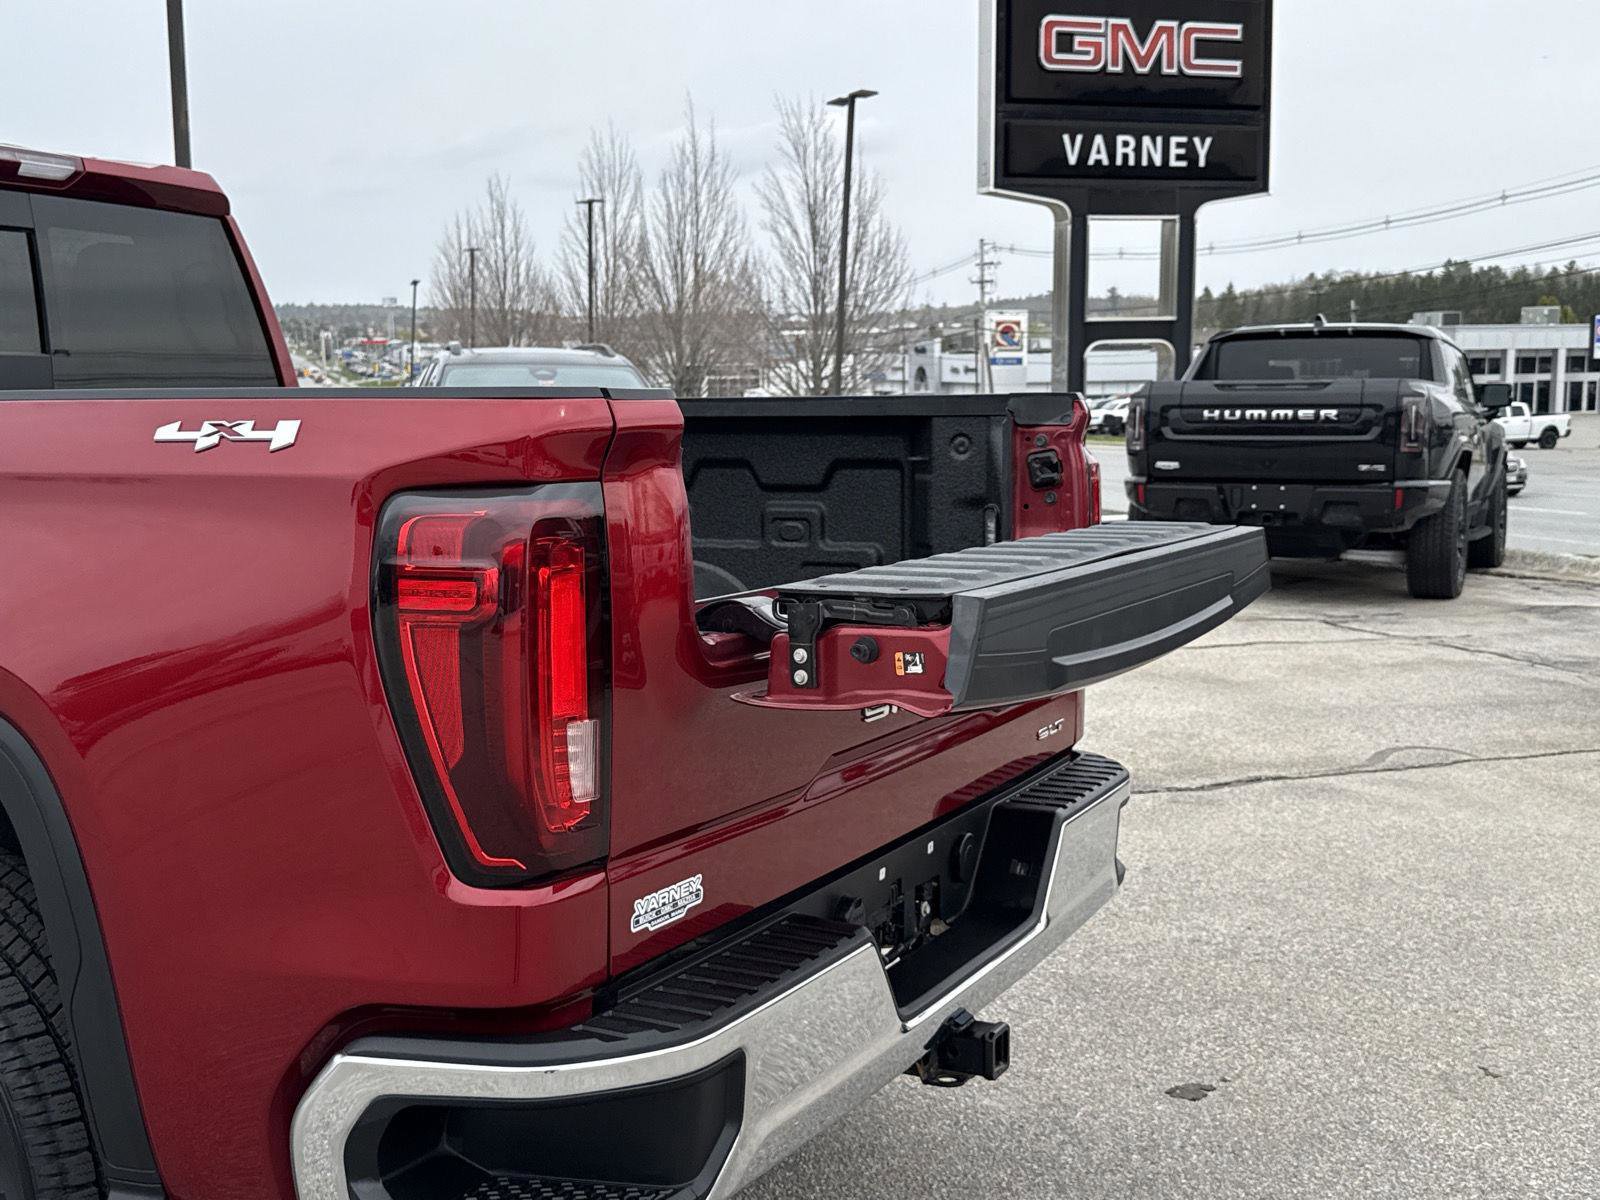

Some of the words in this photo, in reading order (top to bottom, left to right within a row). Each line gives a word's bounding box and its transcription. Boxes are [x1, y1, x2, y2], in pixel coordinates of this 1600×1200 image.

[1039, 14, 1243, 78] GMC
[1062, 133, 1213, 168] VARNEY
[1203, 409, 1339, 421] HUMMER
[1037, 717, 1065, 740] SLT
[636, 877, 701, 915] VARNEY
